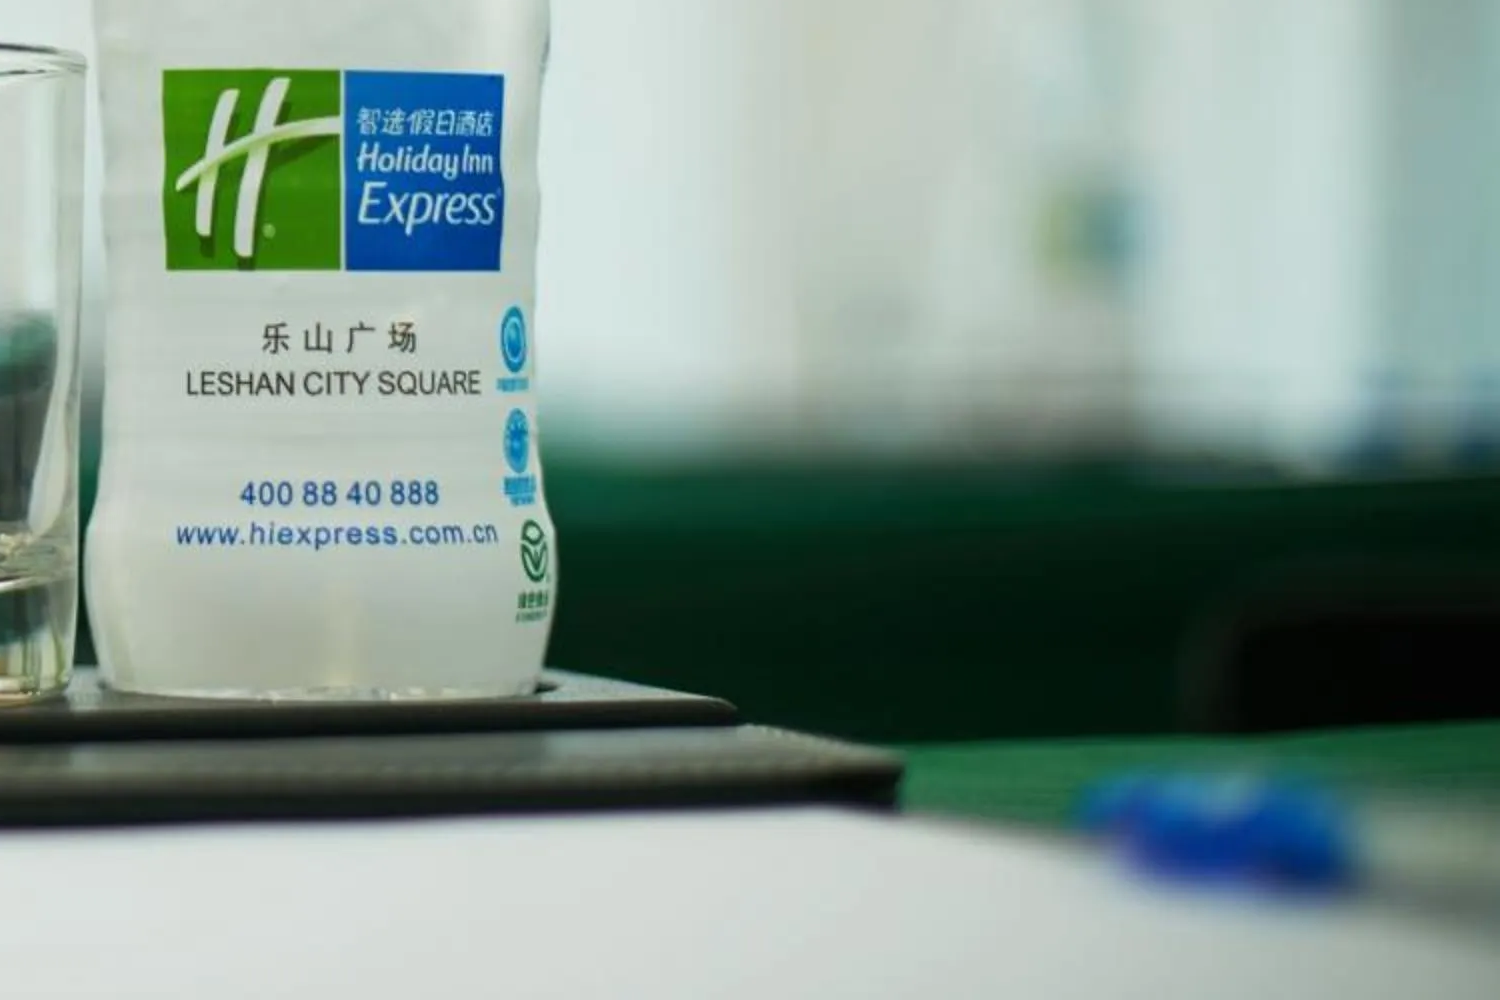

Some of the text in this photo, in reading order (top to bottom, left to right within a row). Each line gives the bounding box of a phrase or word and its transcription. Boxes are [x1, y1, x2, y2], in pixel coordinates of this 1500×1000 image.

[358, 107, 494, 136] 智选假日酒店
[357, 142, 493, 180] Holiday Inn
[357, 182, 497, 235] Express
[262, 322, 417, 354] 乐山广场
[186, 371, 295, 396] LESHAN
[303, 371, 370, 396] CITY
[377, 370, 481, 396] SQUARE
[240, 481, 440, 506] 400 88 40 888
[176, 522, 499, 551] www.hiexpress.com.cn
